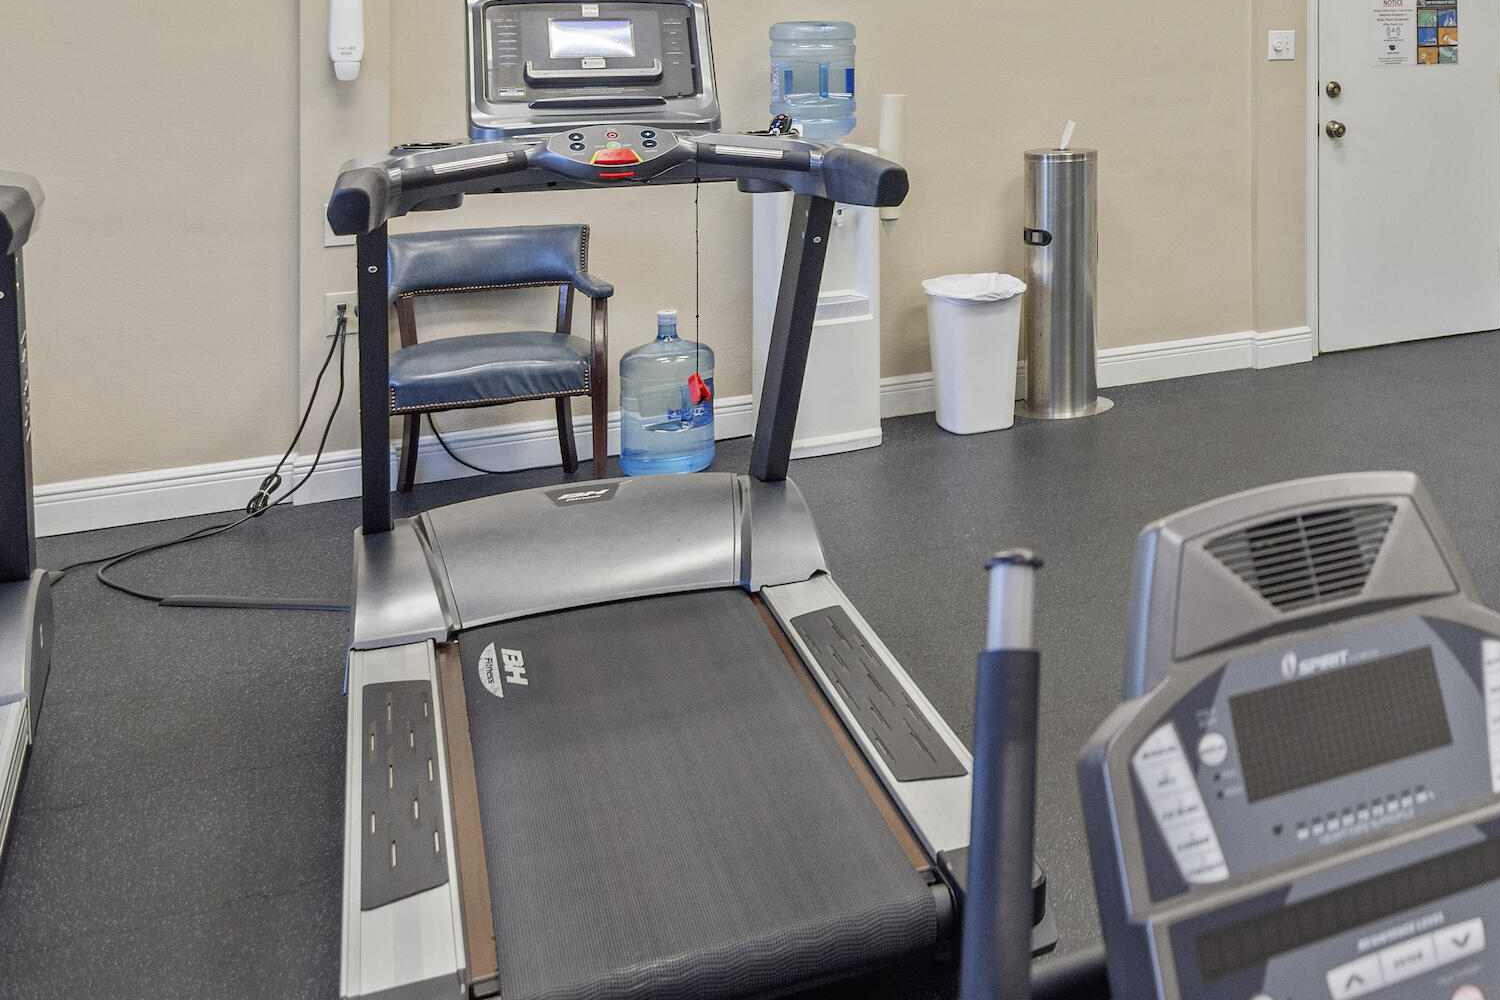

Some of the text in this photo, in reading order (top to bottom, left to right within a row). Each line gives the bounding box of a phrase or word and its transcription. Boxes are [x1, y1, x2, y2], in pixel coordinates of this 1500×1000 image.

[484, 657, 495, 684] Fitness
[501, 648, 528, 686] BH
[1299, 649, 1350, 677] SPIRIT
